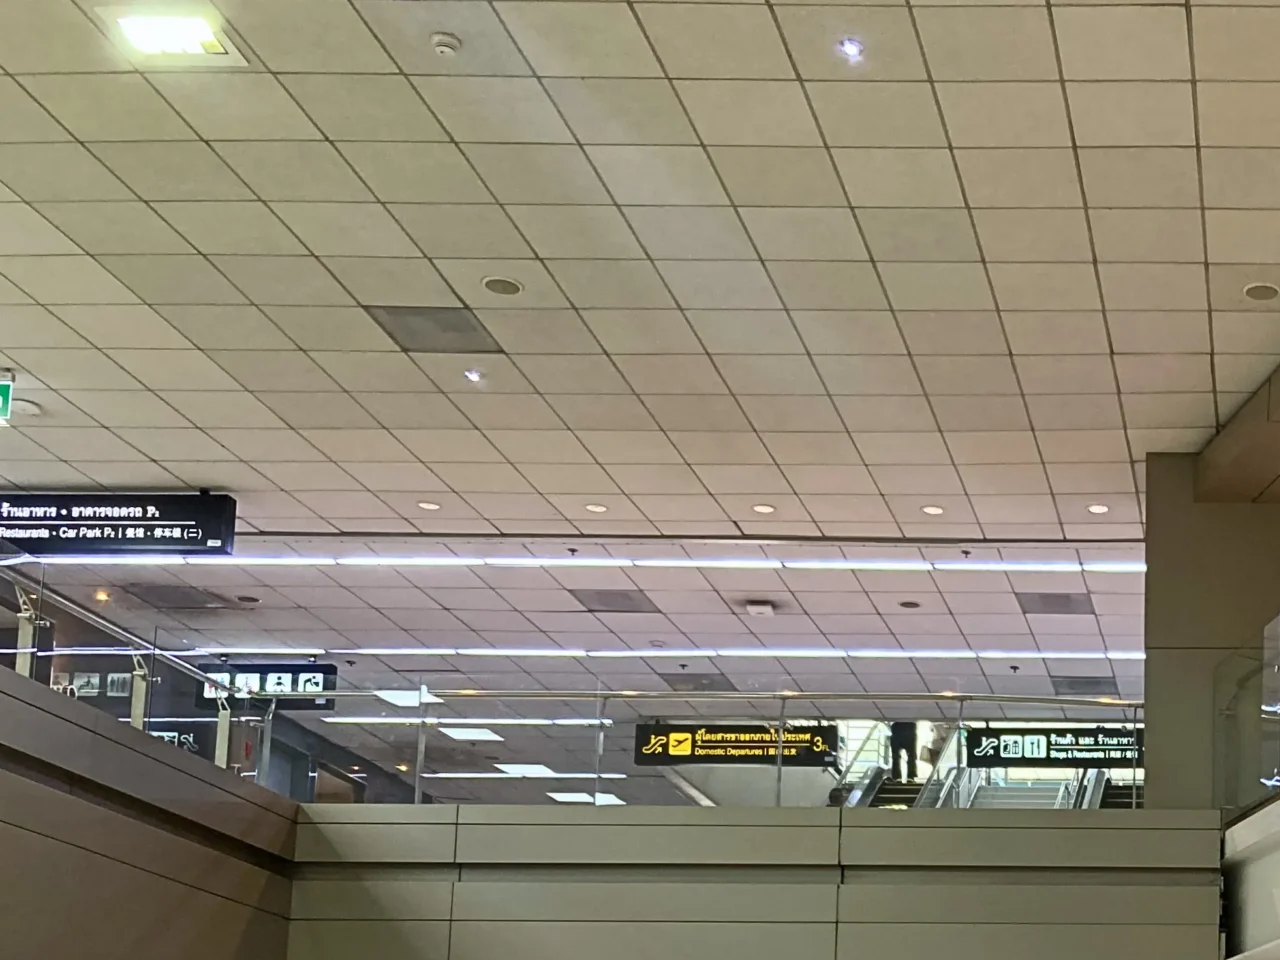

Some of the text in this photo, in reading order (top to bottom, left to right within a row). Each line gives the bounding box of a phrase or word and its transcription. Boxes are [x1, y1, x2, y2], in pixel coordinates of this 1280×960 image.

[0, 527, 49, 539] Restaurants
[59, 527, 77, 539] Car
[79, 527, 102, 539] Park
[694, 747, 725, 756] Domestic
[726, 747, 763, 757] Departures
